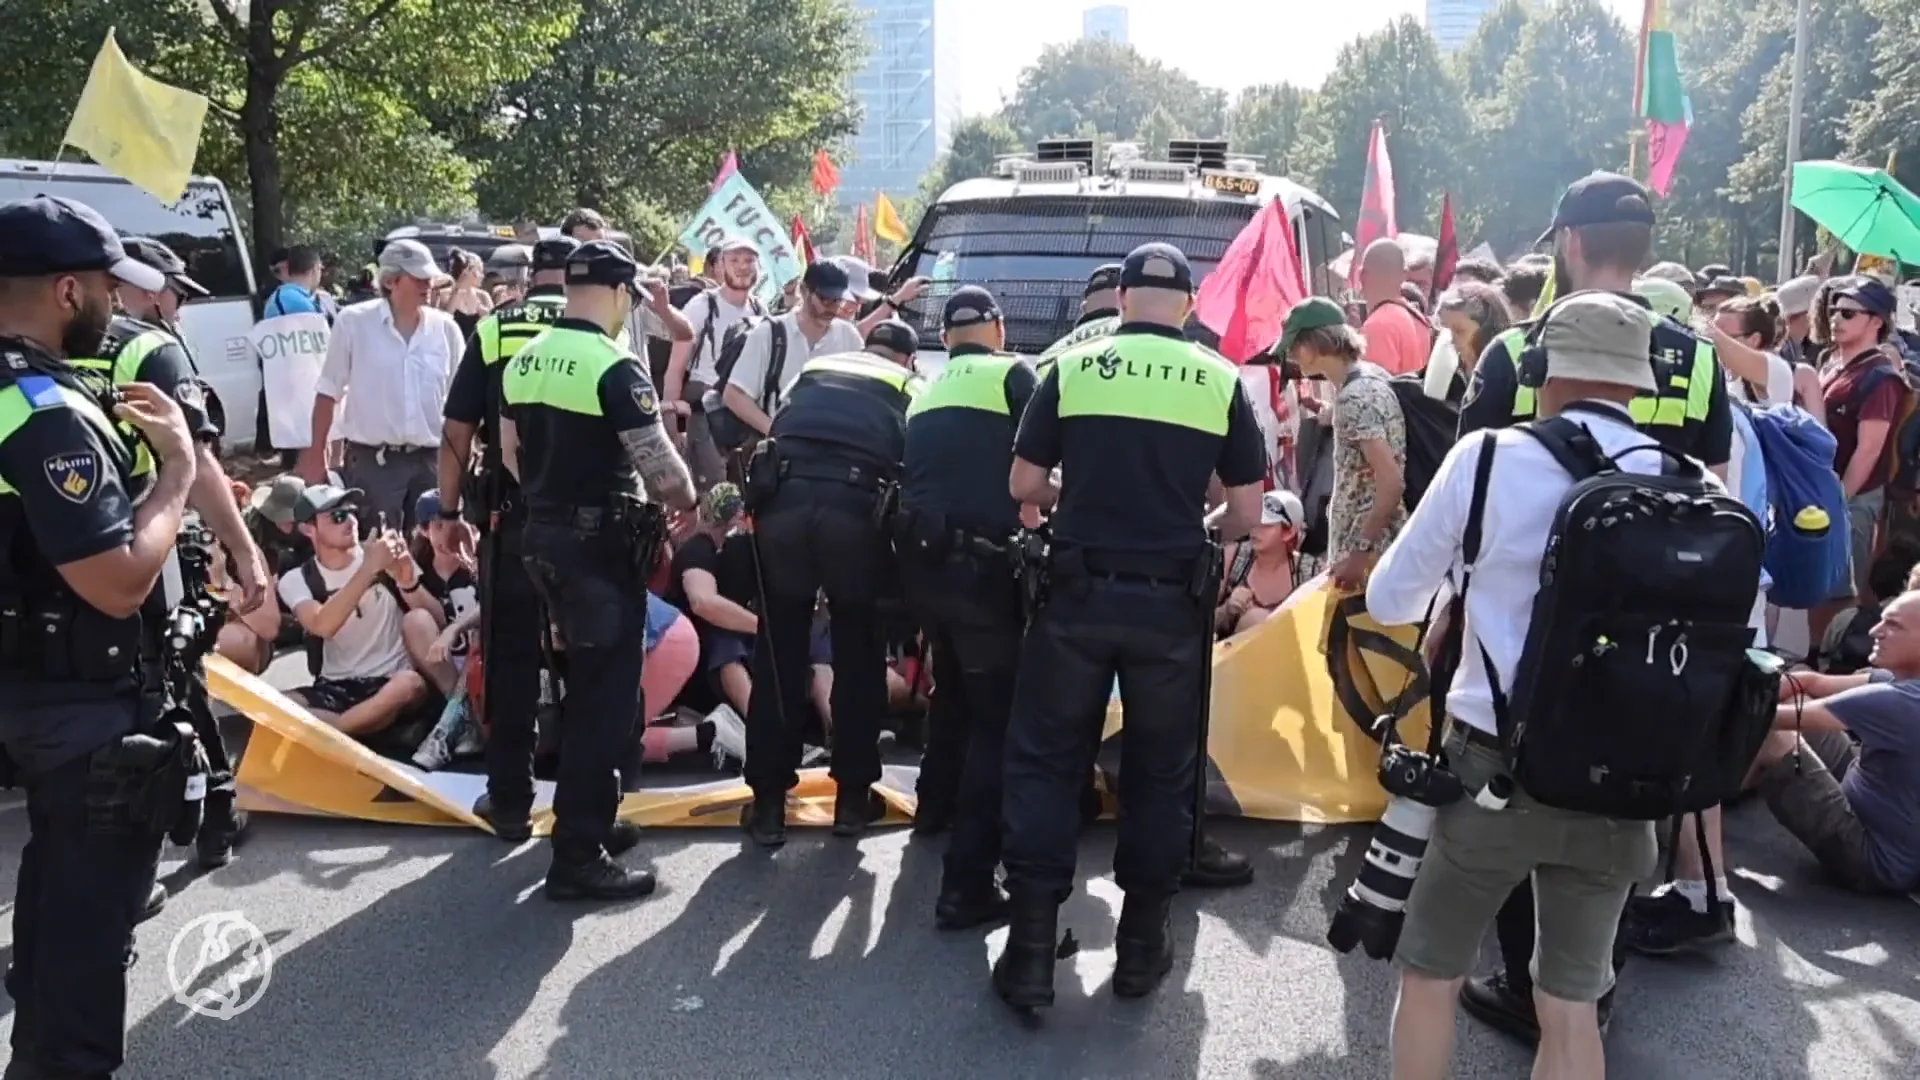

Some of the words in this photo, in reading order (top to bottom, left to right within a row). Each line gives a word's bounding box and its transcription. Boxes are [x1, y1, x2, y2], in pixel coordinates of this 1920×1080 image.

[723, 191, 790, 264] FUCK
[1081, 345, 1208, 386] POLITIE
[48, 456, 92, 472] POLITIE
